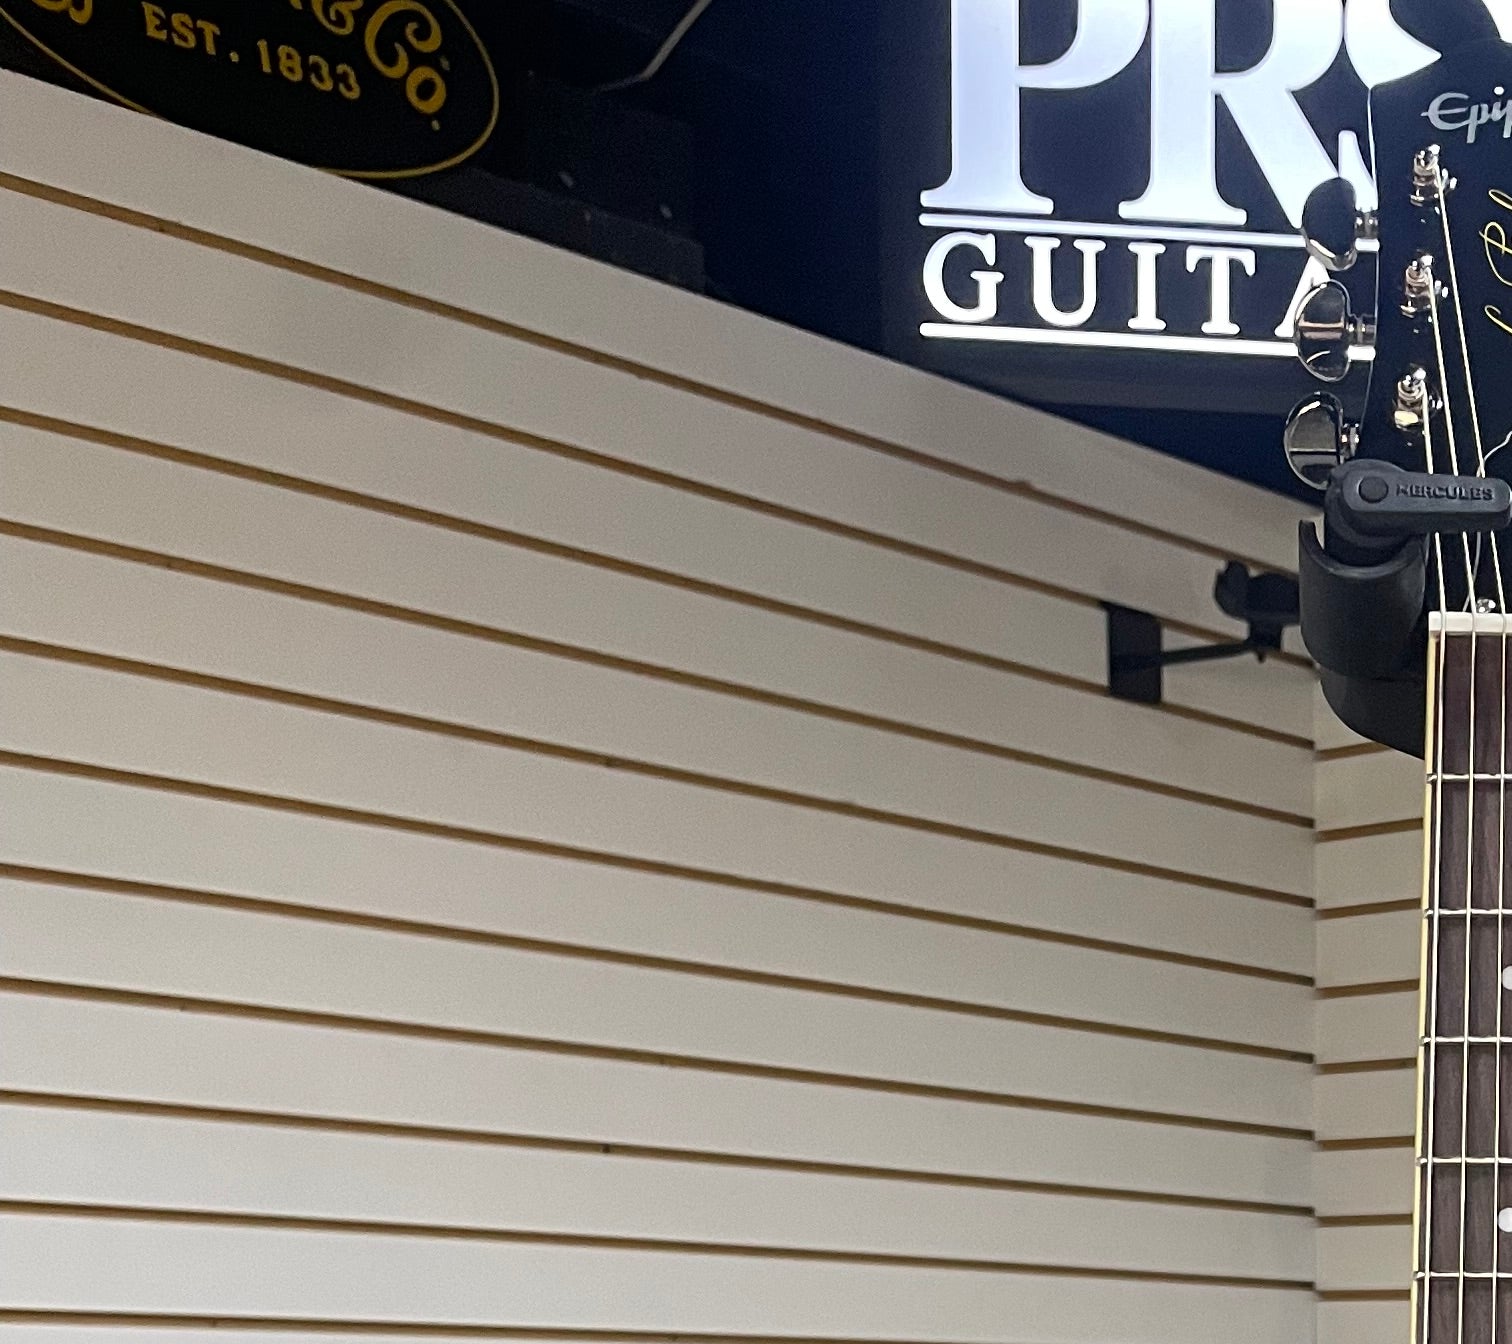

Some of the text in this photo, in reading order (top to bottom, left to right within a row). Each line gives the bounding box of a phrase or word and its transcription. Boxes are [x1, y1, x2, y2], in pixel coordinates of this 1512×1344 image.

[141, 1, 361, 99] EST. 1833
[922, 231, 1330, 338] GUIT
[1396, 483, 1496, 501] HERCULES
